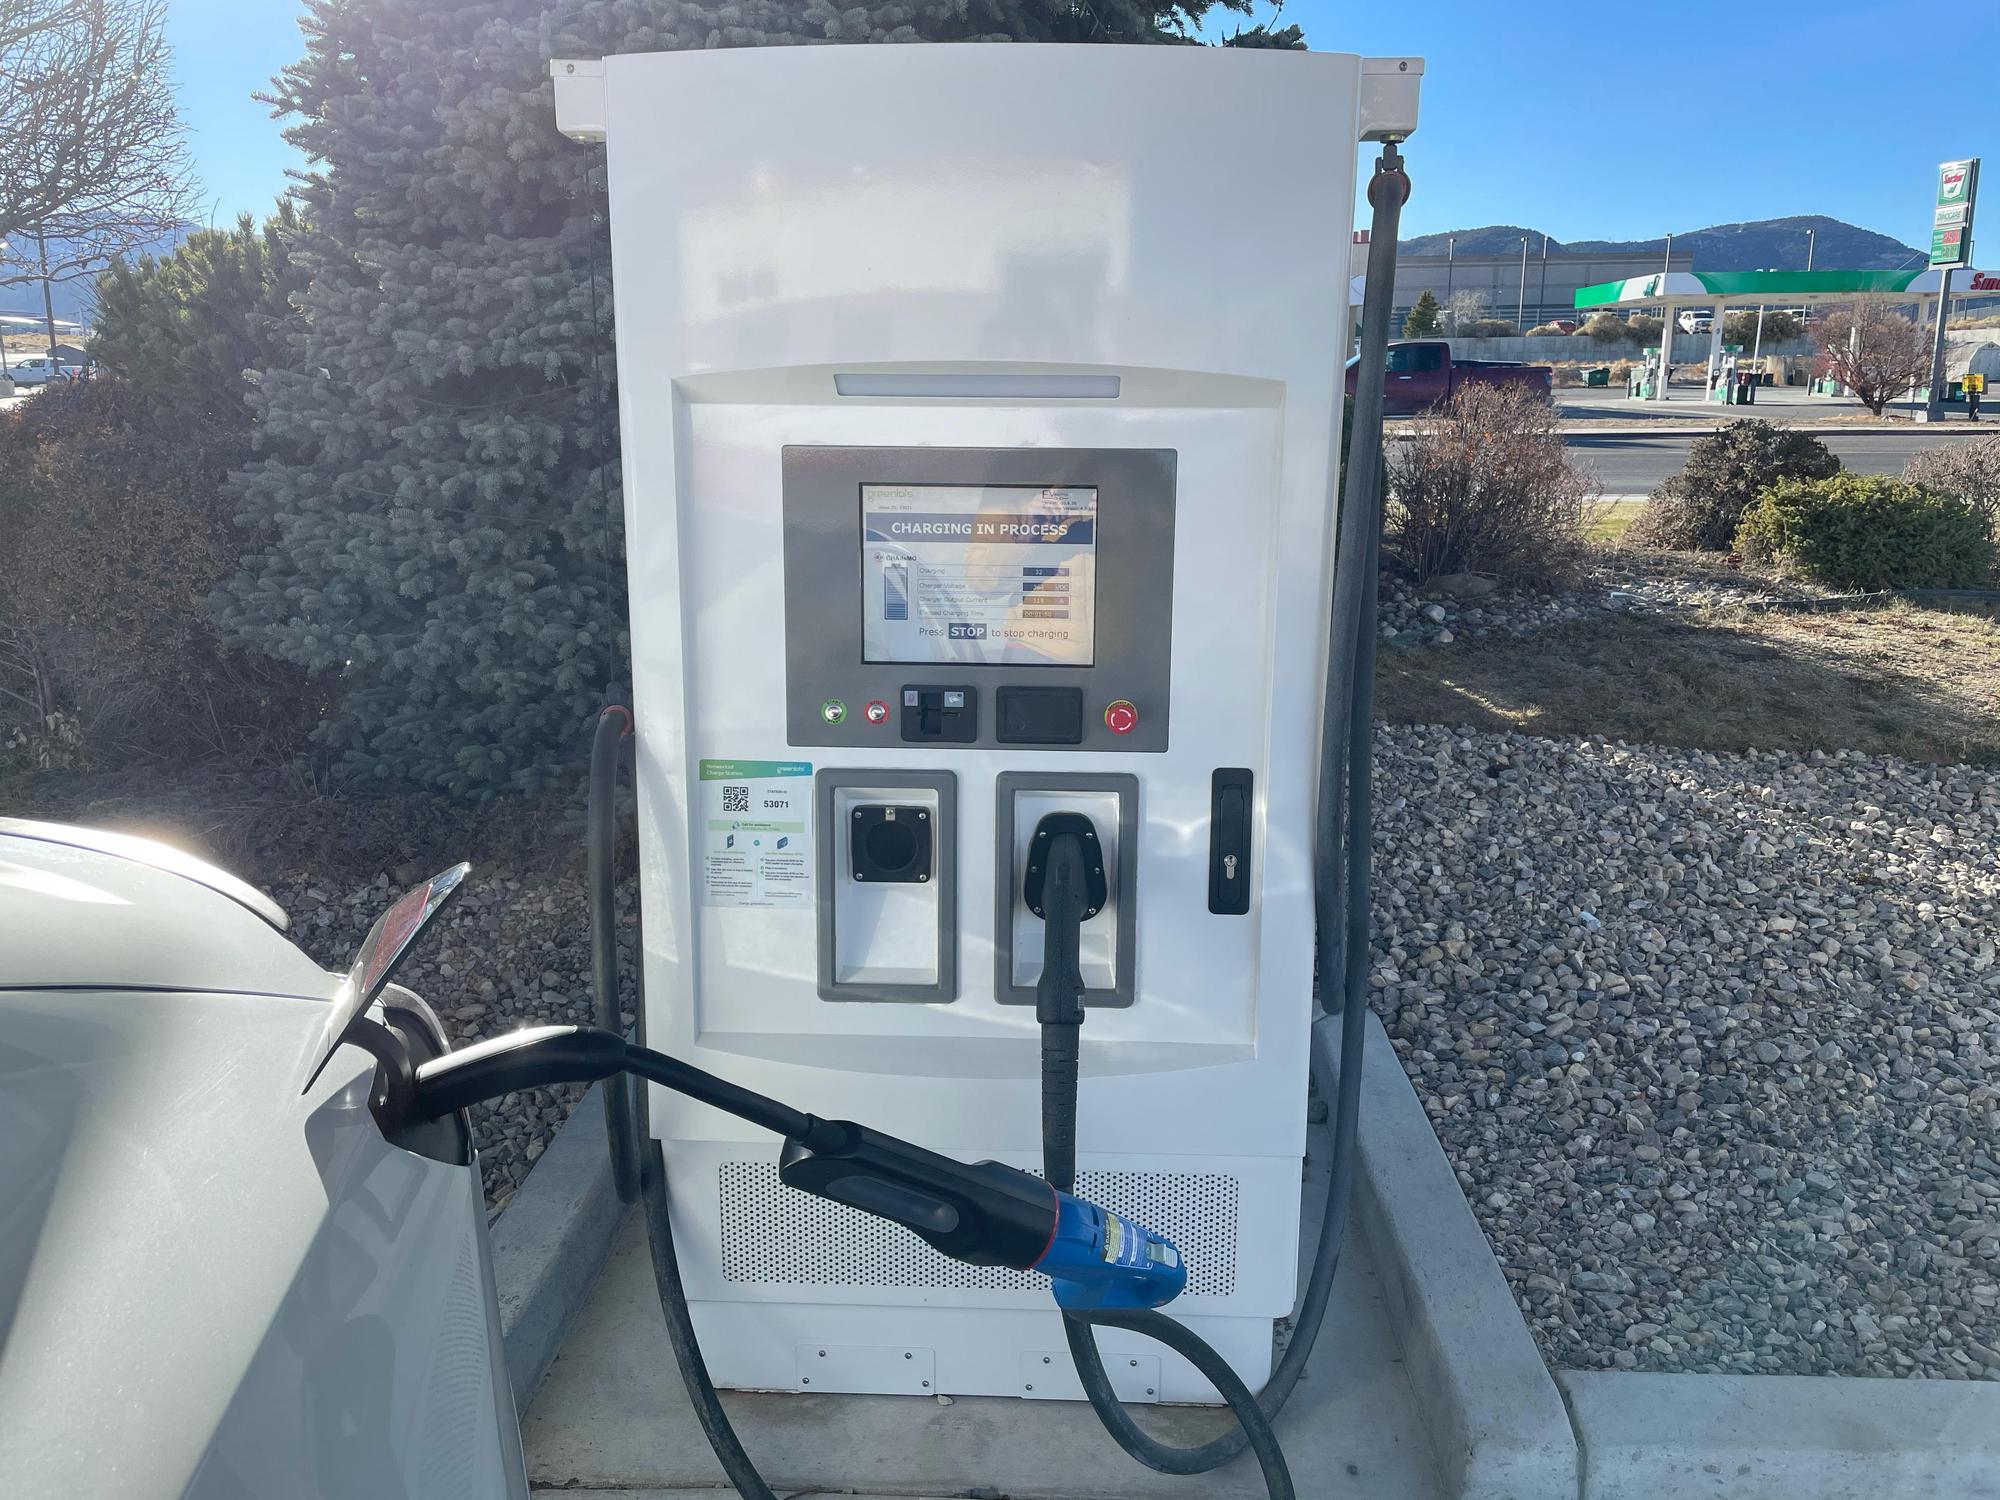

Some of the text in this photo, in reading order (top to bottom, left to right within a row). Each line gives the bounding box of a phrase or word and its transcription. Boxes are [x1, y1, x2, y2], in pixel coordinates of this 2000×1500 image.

[891, 521, 1068, 536] CHARGING IN PROCESS
[919, 626, 1069, 640] Press STOP to stop charging
[763, 800, 789, 809] 53071
